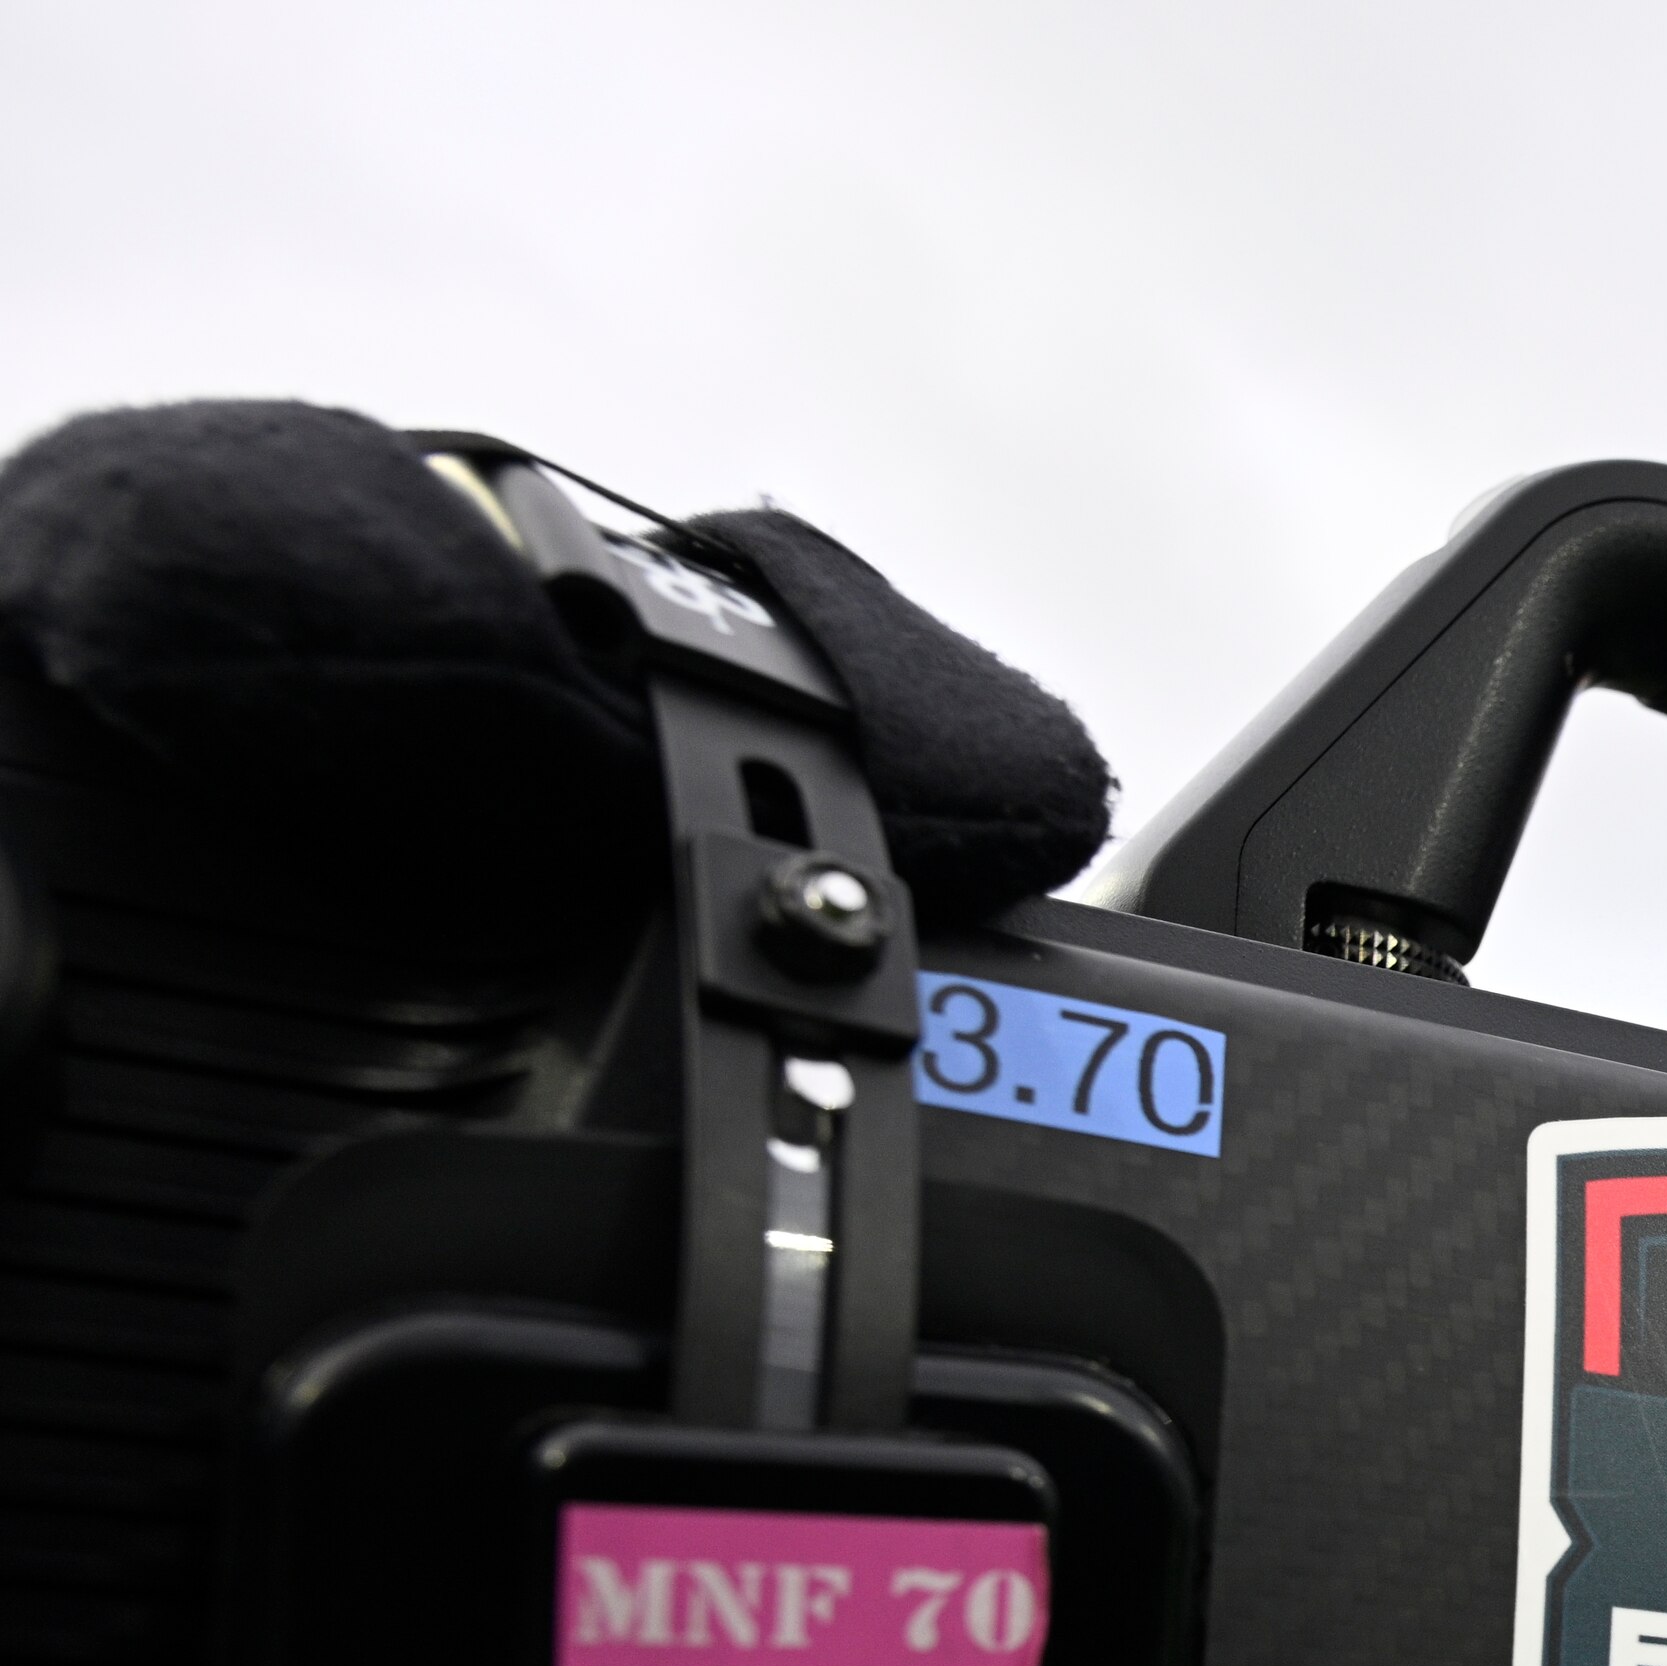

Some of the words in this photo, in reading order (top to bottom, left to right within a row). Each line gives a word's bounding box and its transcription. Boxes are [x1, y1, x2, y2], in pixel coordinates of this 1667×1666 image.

[922, 984, 1213, 1136] 3.70
[573, 1556, 853, 1649] MNF
[889, 1566, 1037, 1654] 70
